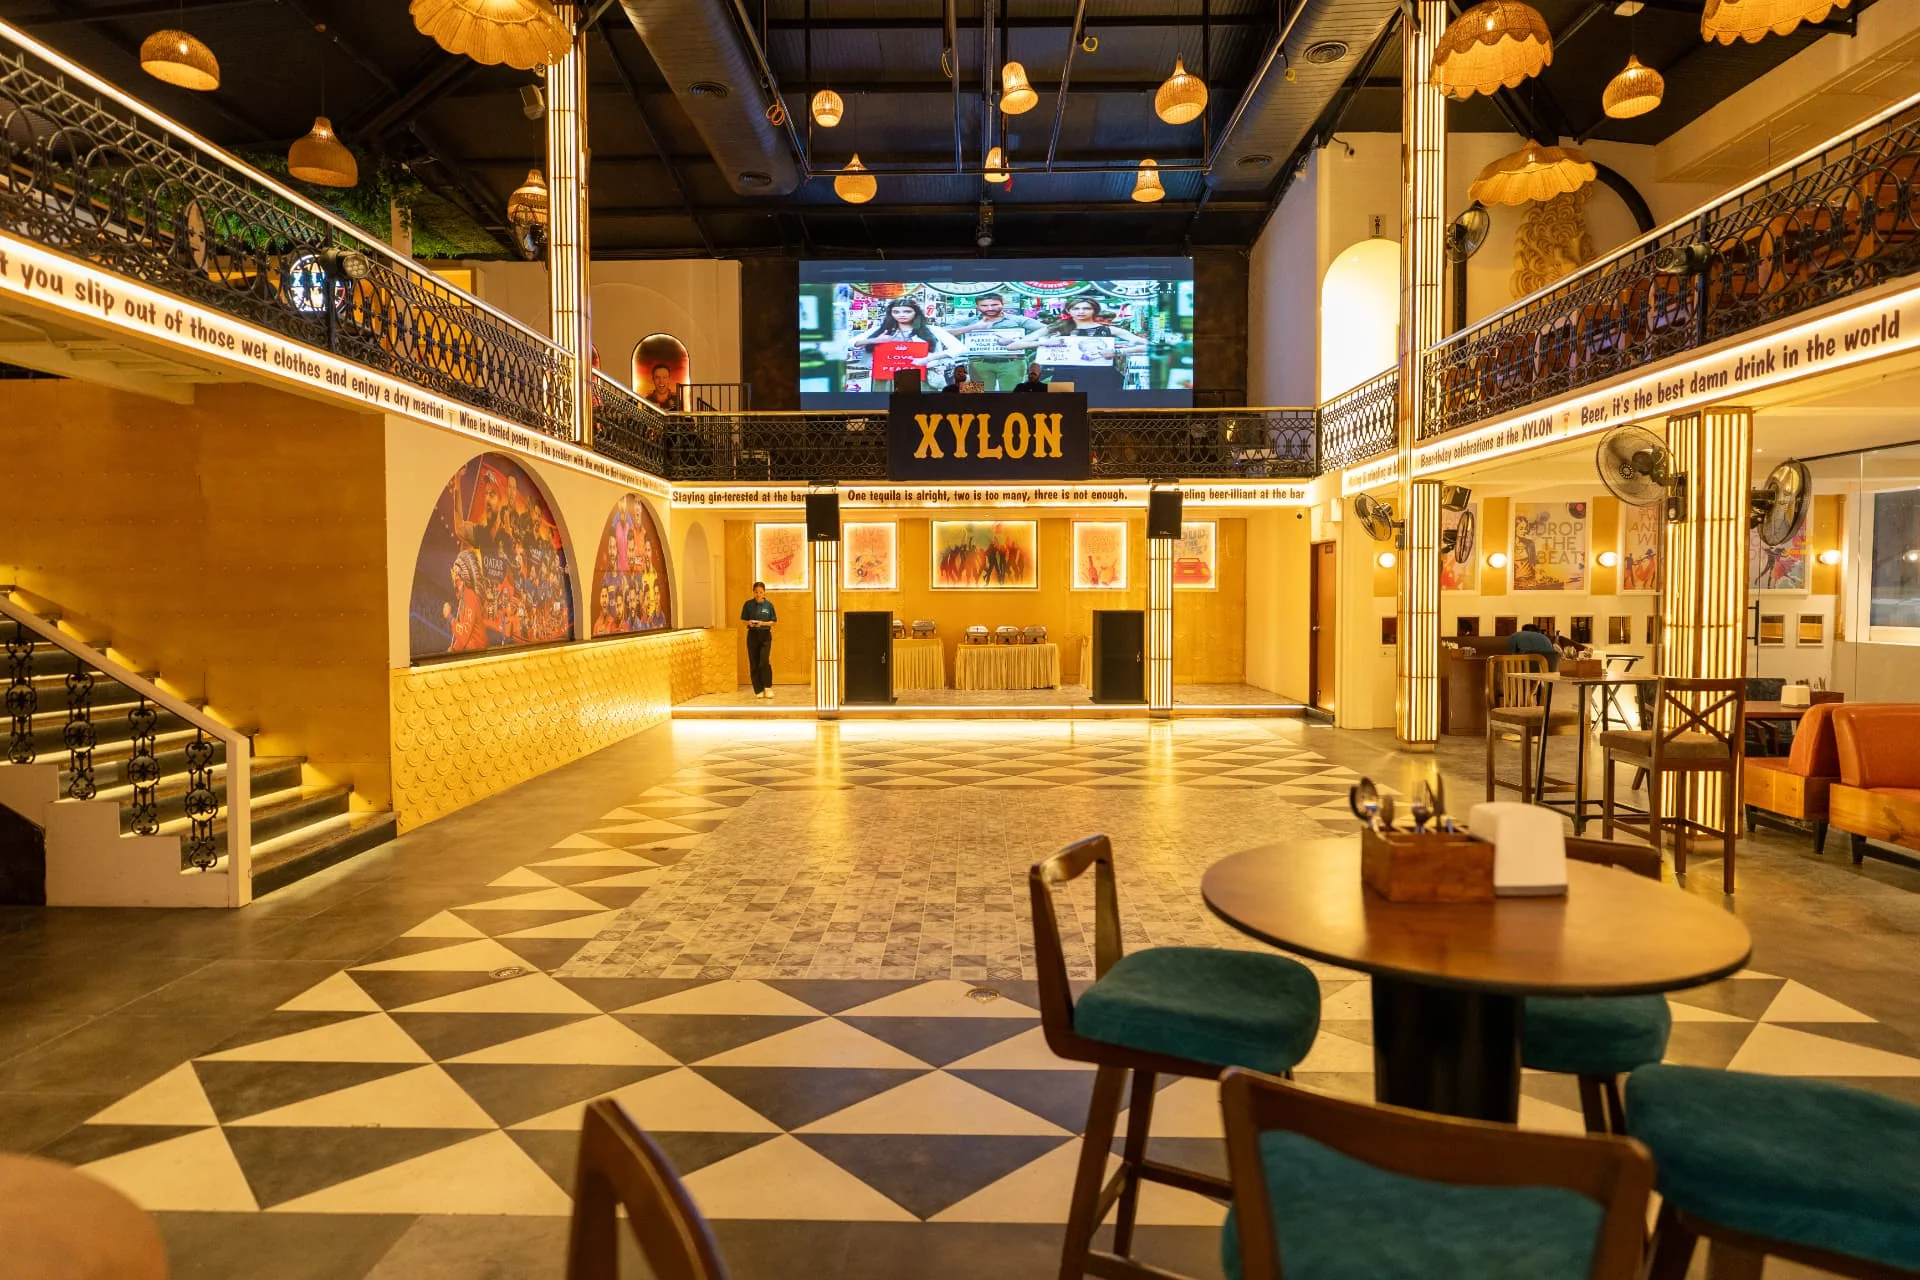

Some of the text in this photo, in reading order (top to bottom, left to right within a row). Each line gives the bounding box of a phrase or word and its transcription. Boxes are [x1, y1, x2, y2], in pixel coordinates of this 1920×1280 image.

[21, 263, 64, 295] you
[75, 278, 115, 316] slip
[124, 299, 156, 325] out
[164, 309, 183, 334] of
[190, 316, 235, 350] those
[242, 340, 268, 362] wet
[274, 347, 321, 379] clothes
[326, 368, 347, 388] and
[352, 376, 380, 402] enjoy
[384, 388, 390, 402] a
[394, 387, 410, 413] dry
[413, 398, 444, 420] martini
[1581, 310, 1900, 426] Beer, it's the best damn drink in the world
[460, 410, 530, 451] Wine is bottled poetry
[913, 412, 1064, 460] XYLON
[1454, 436, 1494, 460] celebrations
[1496, 432, 1504, 448] at
[1506, 428, 1519, 446] the
[1522, 414, 1553, 442] XYLON
[541, 441, 550, 456] The
[672, 491, 806, 504] Staying gin-terested at the bar
[848, 488, 1128, 503] One tequila is alright, two is too many, three is not enough.
[1210, 488, 1256, 500] beer-illiant
[1260, 488, 1269, 500] at
[1272, 488, 1286, 500] the
[1290, 488, 1305, 500] bar
[1534, 521, 1584, 536] DROP
[1542, 536, 1576, 550] THE
[484, 556, 504, 570] QATAR
[1536, 551, 1579, 565] BEAT
